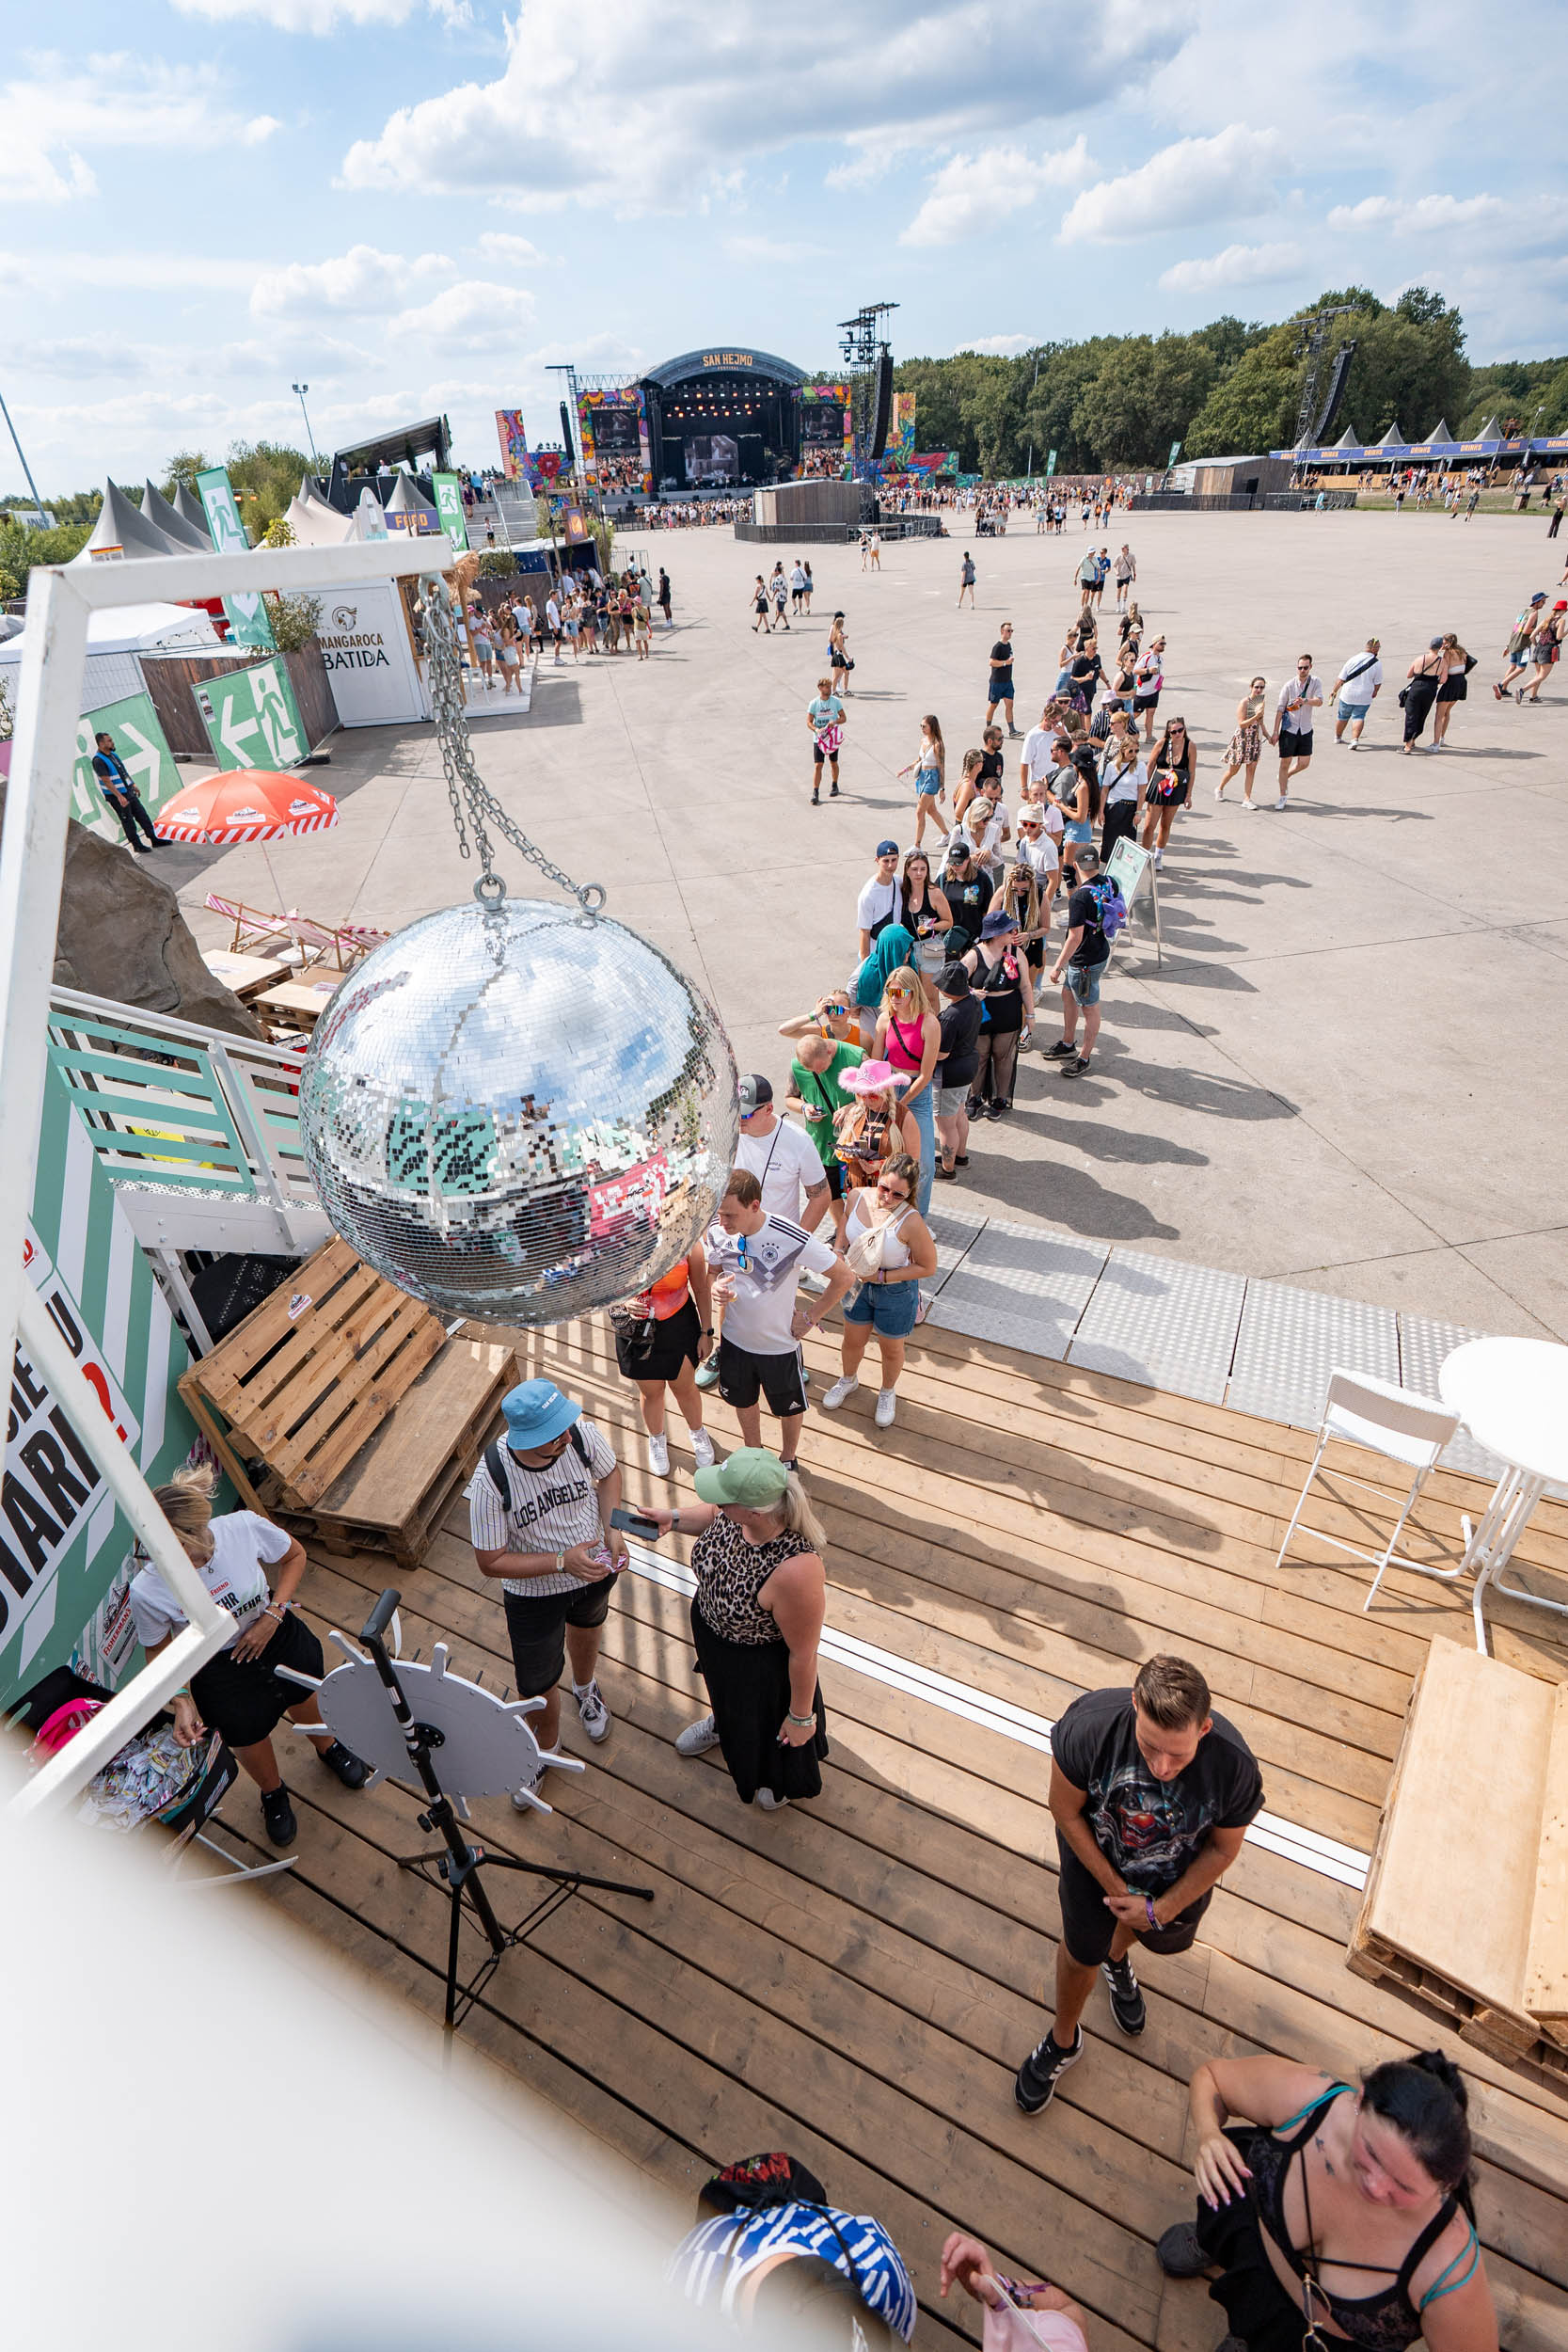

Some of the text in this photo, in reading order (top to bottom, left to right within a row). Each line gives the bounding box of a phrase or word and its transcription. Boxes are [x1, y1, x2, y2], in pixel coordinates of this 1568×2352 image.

[703, 353, 752, 367] SAN HEJMO
[1460, 443, 1483, 452] DRINKS
[395, 513, 429, 528] FOOD
[320, 633, 384, 649] MANGAROCA
[323, 649, 390, 670] BATIDA
[514, 1481, 588, 1529] LOS ANGELES
